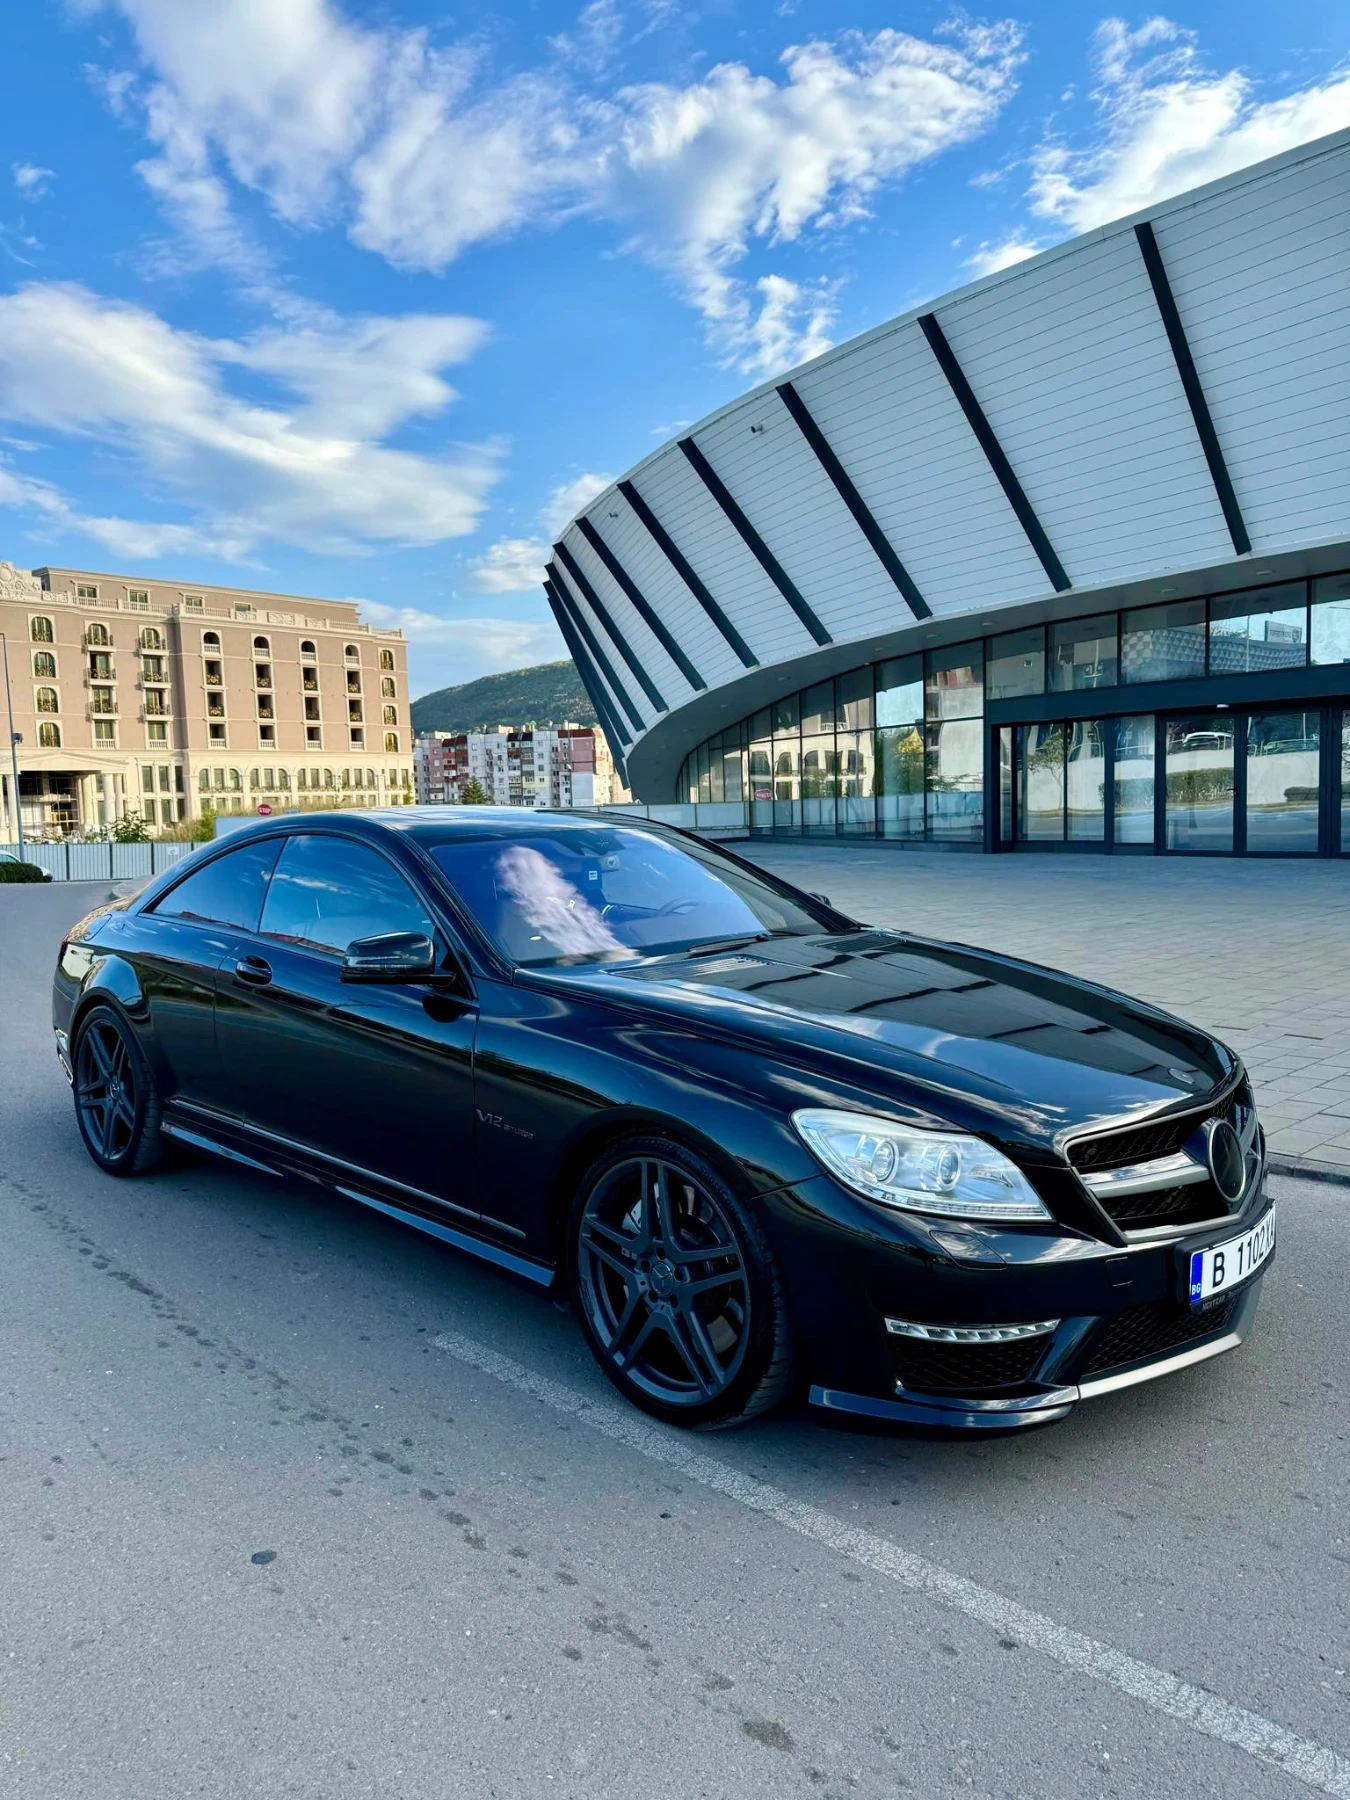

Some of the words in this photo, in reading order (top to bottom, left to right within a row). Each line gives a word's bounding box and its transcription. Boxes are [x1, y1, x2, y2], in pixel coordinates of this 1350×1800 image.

[476, 1108, 502, 1128] V12
[1212, 1251, 1225, 1288] B
[1237, 1226, 1265, 1276] 1102
[1191, 1283, 1201, 1294] BG
